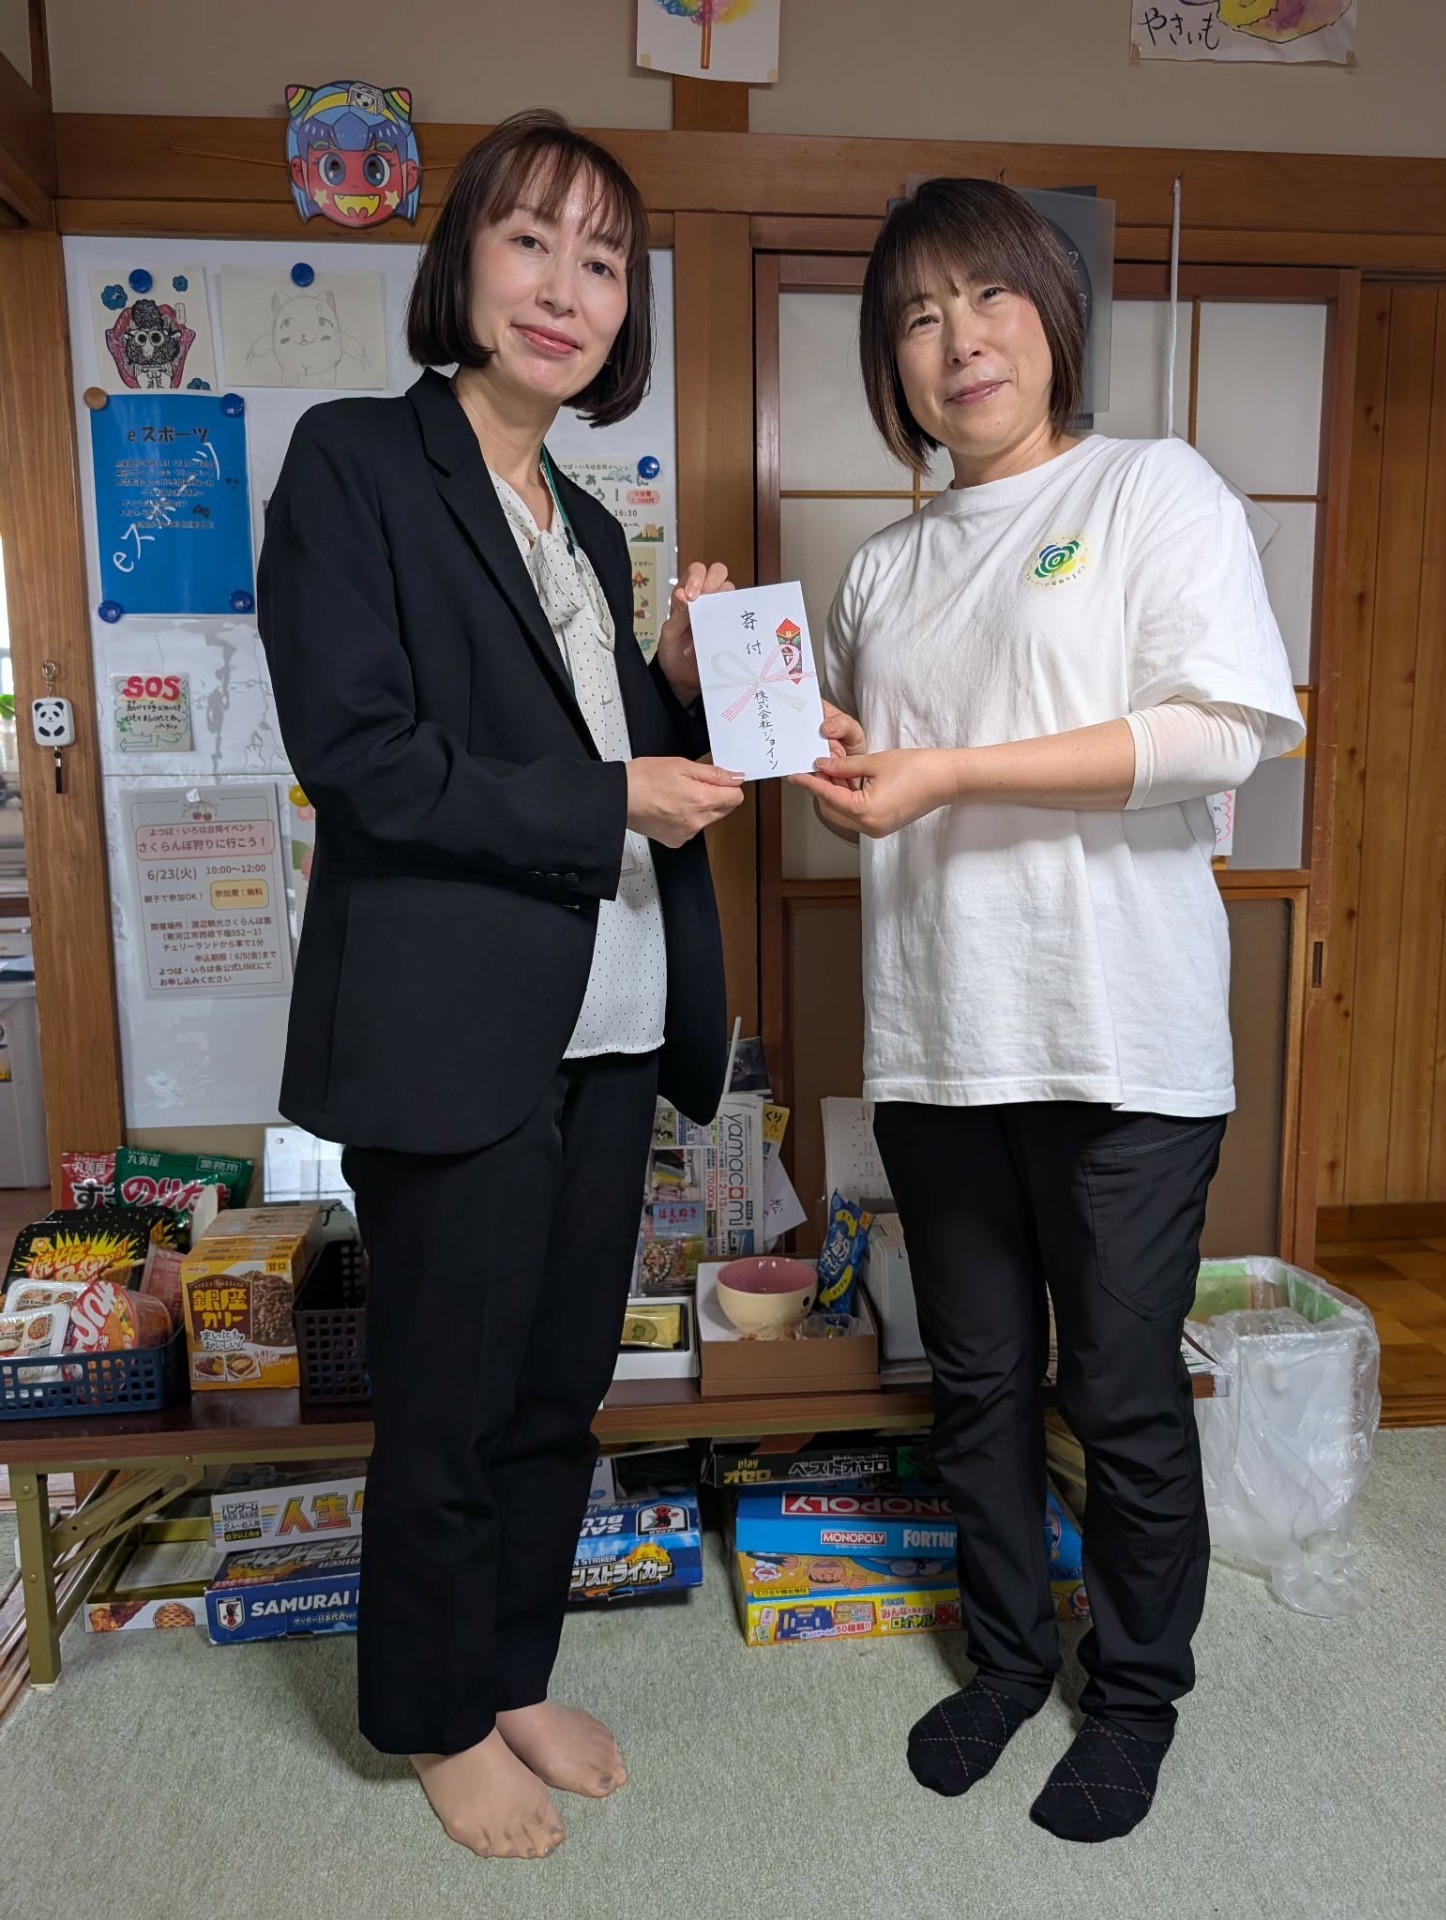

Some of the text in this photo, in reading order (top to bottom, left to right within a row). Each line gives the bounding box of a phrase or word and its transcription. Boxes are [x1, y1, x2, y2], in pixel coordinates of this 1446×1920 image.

[1139, 7, 1220, 50] やきいも
[127, 426, 209, 443] eスポーツ
[741, 611, 762, 656] 寄付
[123, 676, 182, 701] SOS
[753, 690, 779, 770] 株式会社ジョイン
[147, 867, 198, 881] 6/23(火)
[127, 1154, 160, 1168] 丸美屋
[268, 1262, 287, 1272] 甘口
[192, 1288, 248, 1312] 銀座
[202, 1312, 244, 1329] カリー
[737, 1458, 759, 1470] play
[788, 1459, 891, 1476] ベストオセロ
[723, 1468, 772, 1485] オセロ
[823, 1532, 886, 1545] MONOPOLY
[251, 1591, 349, 1617] SAMURAI
